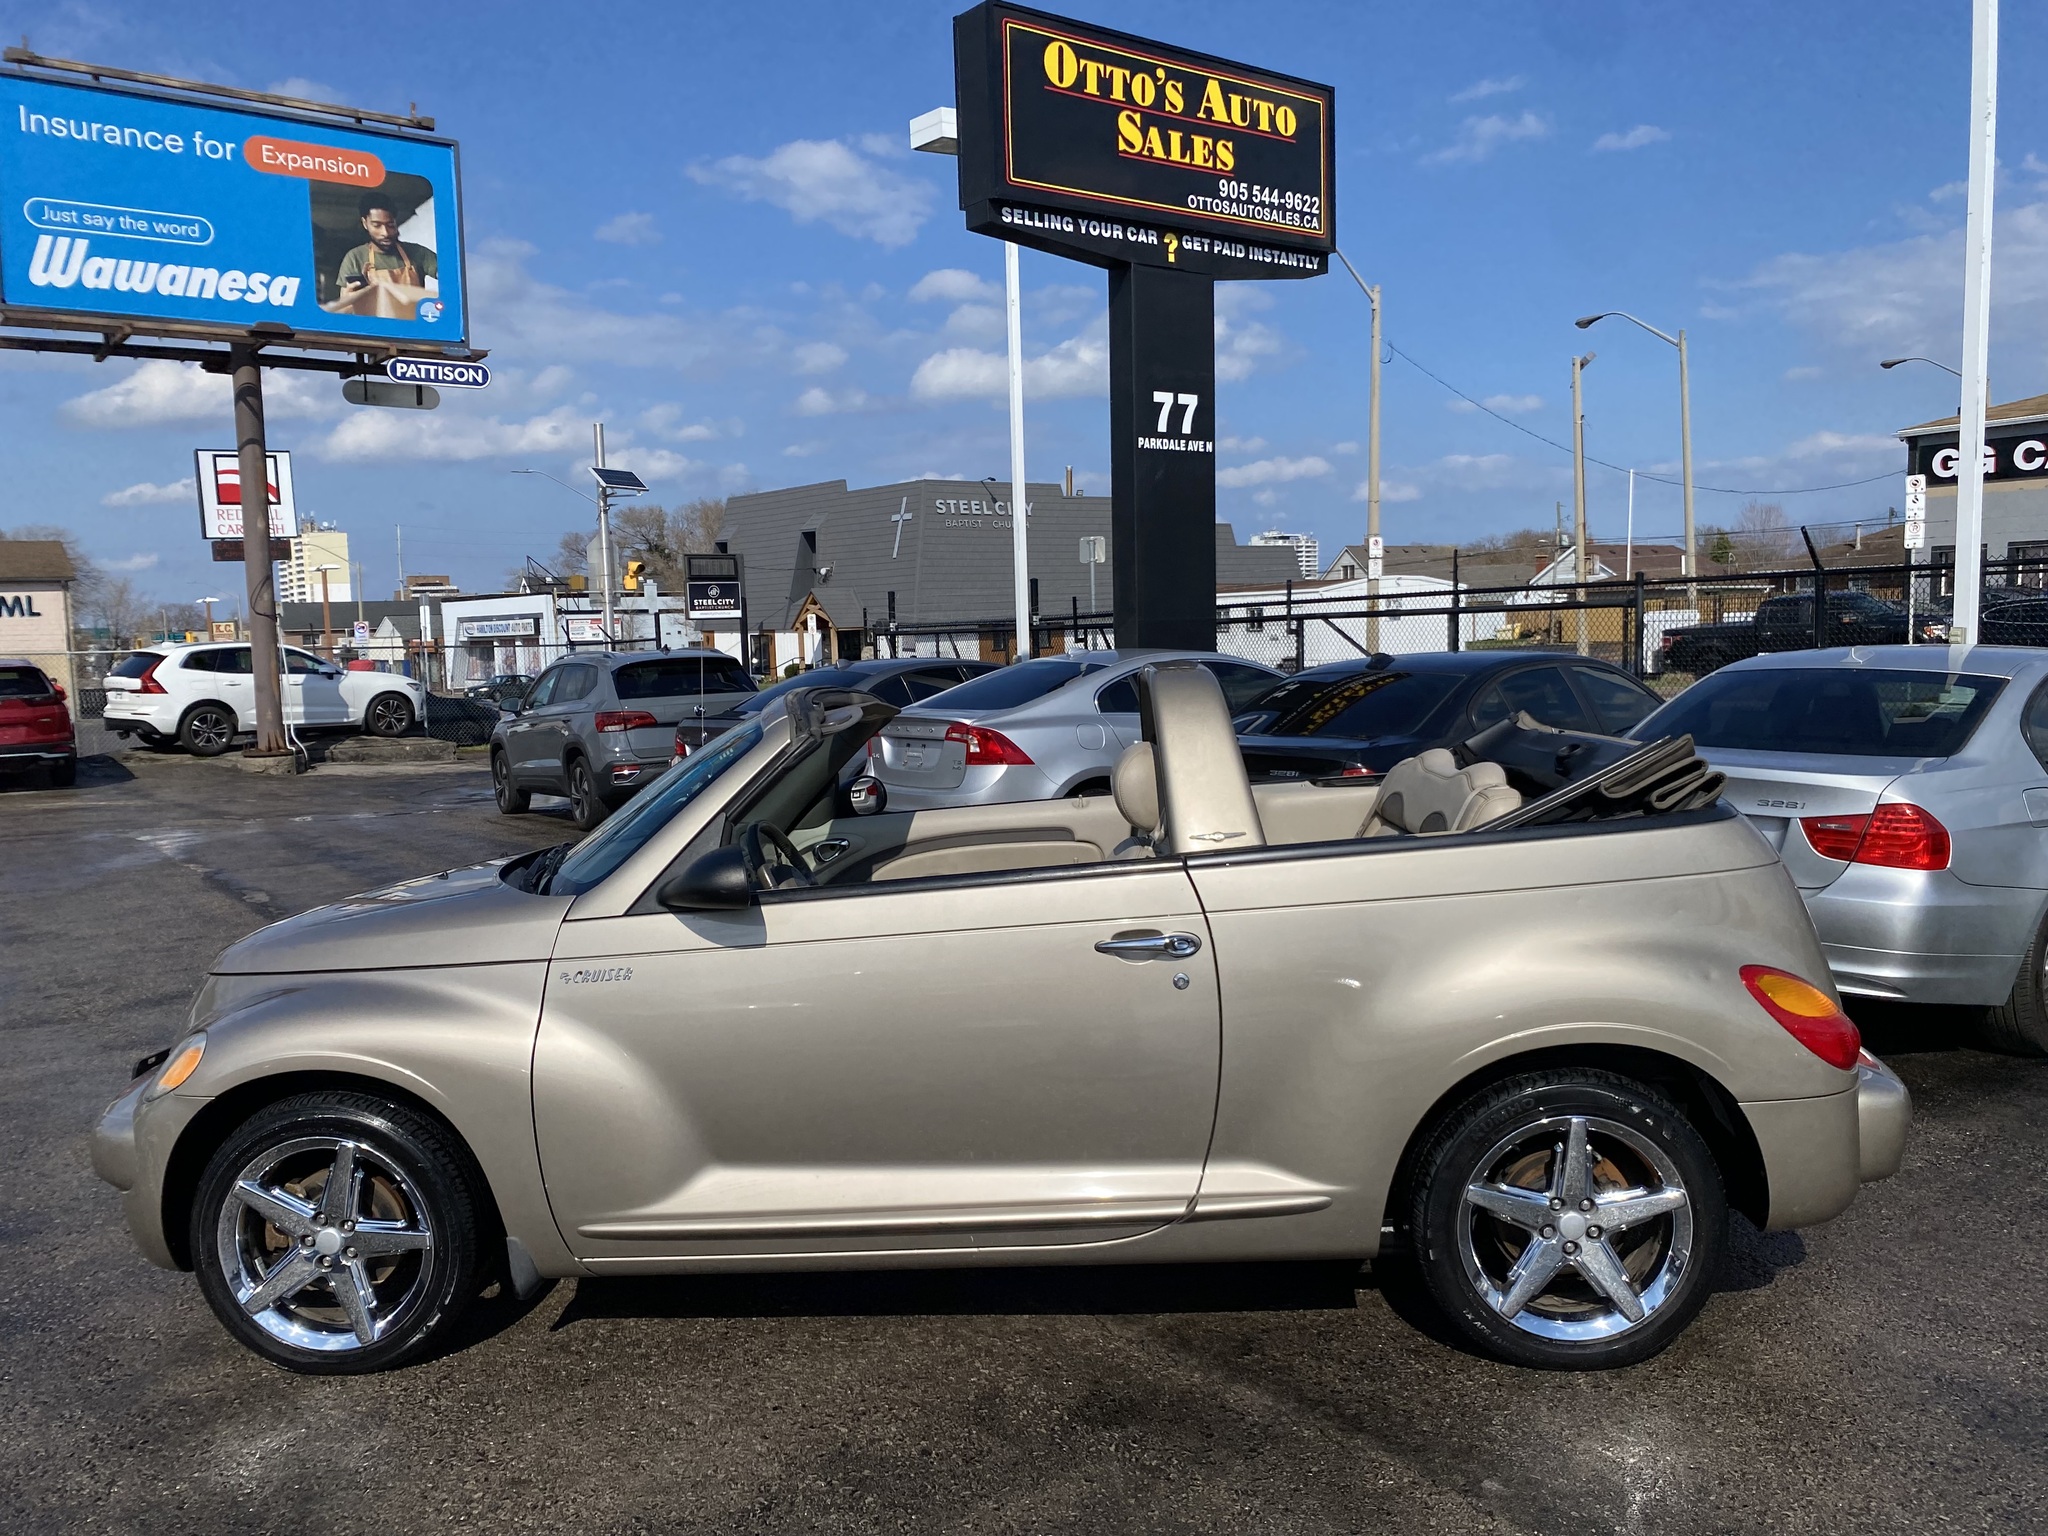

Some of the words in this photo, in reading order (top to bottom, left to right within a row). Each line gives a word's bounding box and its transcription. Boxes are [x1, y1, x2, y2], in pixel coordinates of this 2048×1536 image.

[1043, 40, 1184, 114] OTTO'S
[1197, 78, 1297, 137] AUTO
[19, 104, 184, 153] Insurance
[192, 131, 236, 160] for
[261, 144, 369, 178] Expansion
[1117, 109, 1235, 172] SALES
[1187, 194, 1319, 229] OTTOSAUTOSALES.CA
[1219, 178, 1248, 201] 905
[1252, 185, 1320, 214] 544-9622
[41, 205, 78, 223] Just
[82, 213, 114, 231] say
[120, 215, 148, 231] the
[153, 222, 199, 238] word
[1001, 206, 1074, 233] SELLING
[1077, 218, 1123, 240] YOUR
[1126, 226, 1158, 245] CAR
[1181, 235, 1211, 253] GET
[1213, 240, 1246, 258] PAID
[1248, 246, 1320, 270] INSTANTLY
[28, 234, 301, 307] Wawanesa
[396, 362, 483, 384] PATTISON
[1153, 391, 1198, 434] 77
[1137, 437, 1186, 451] PARKDALE
[1187, 440, 1204, 452] AVE
[1205, 441, 1213, 453] N
[2013, 439, 2048, 471] C
[935, 499, 993, 515] STEEL
[994, 501, 1034, 516] CIY
[945, 519, 982, 528] BAPTIST
[992, 520, 1030, 529] CHUH
[572, 967, 633, 984] CRUISER
